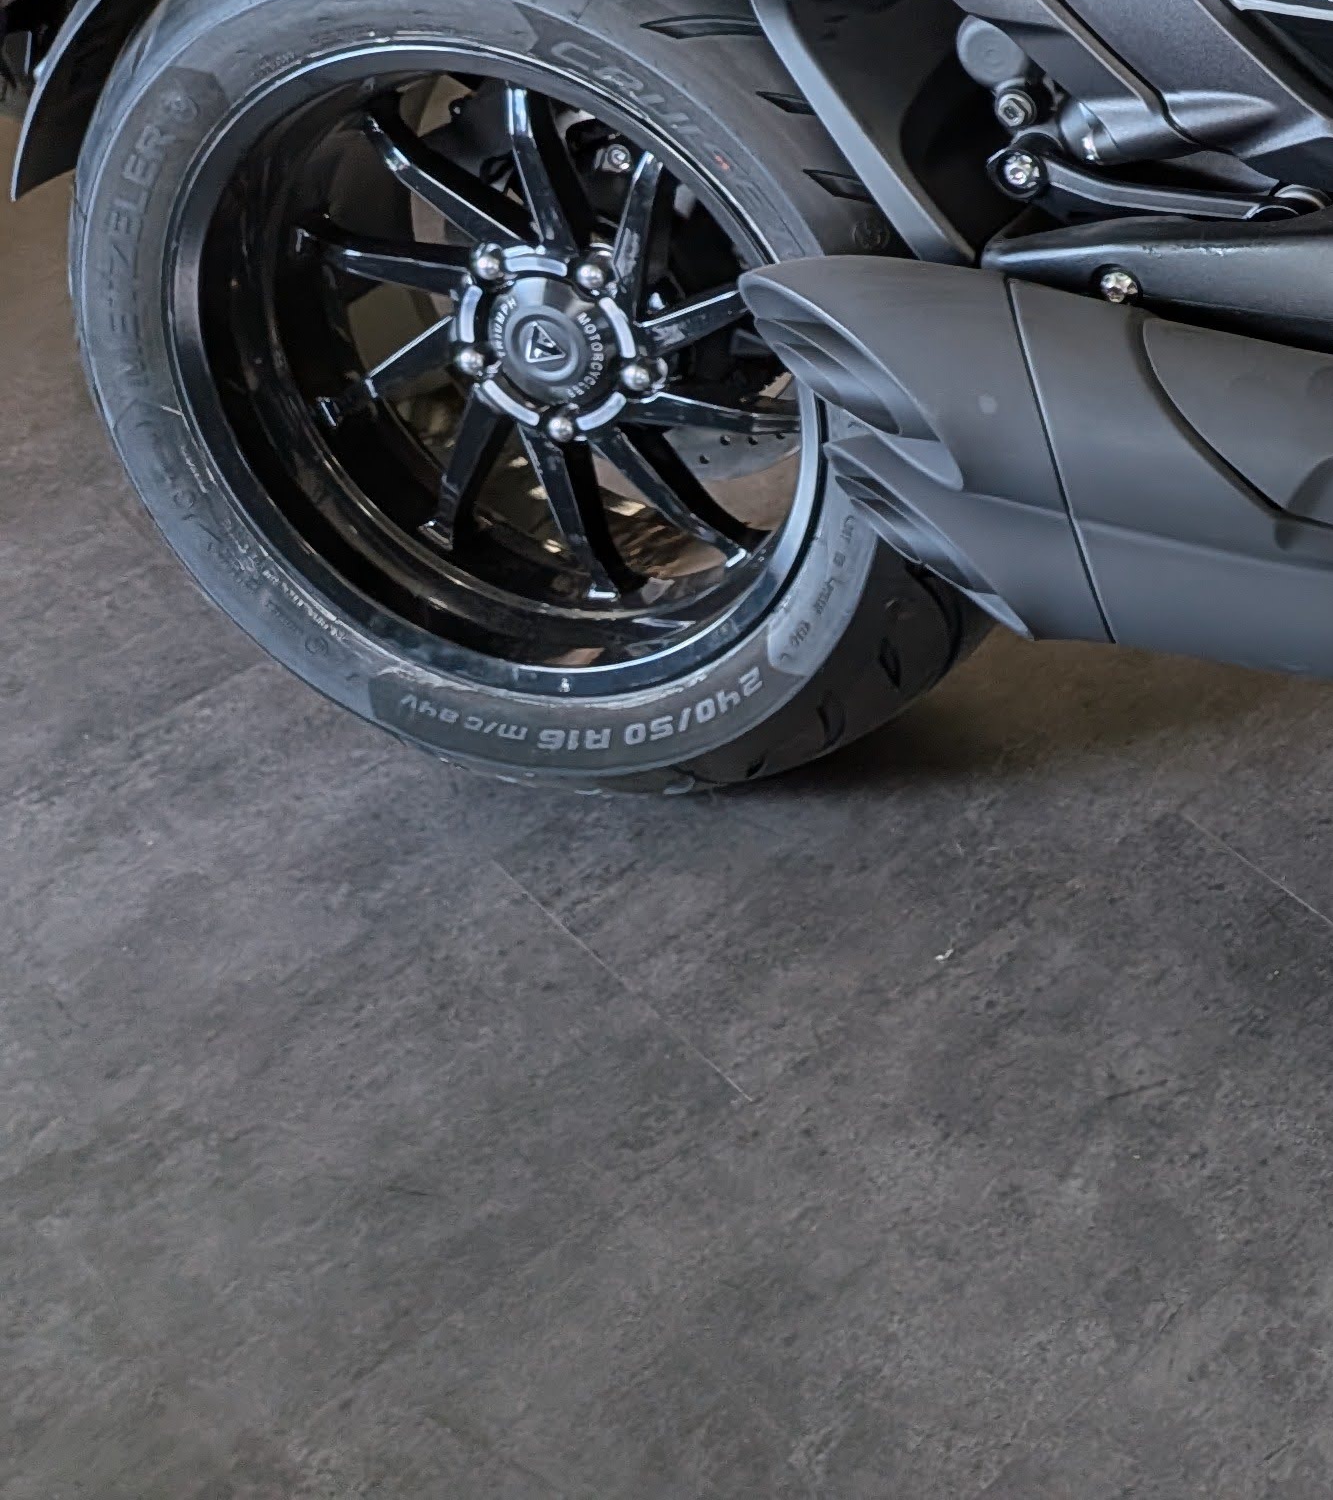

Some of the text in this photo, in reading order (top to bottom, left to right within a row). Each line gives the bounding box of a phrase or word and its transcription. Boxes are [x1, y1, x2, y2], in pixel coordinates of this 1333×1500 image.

[566, 312, 605, 399] MOTORCYCLES
[536, 728, 612, 752] R16
[624, 666, 765, 747] 240/50
